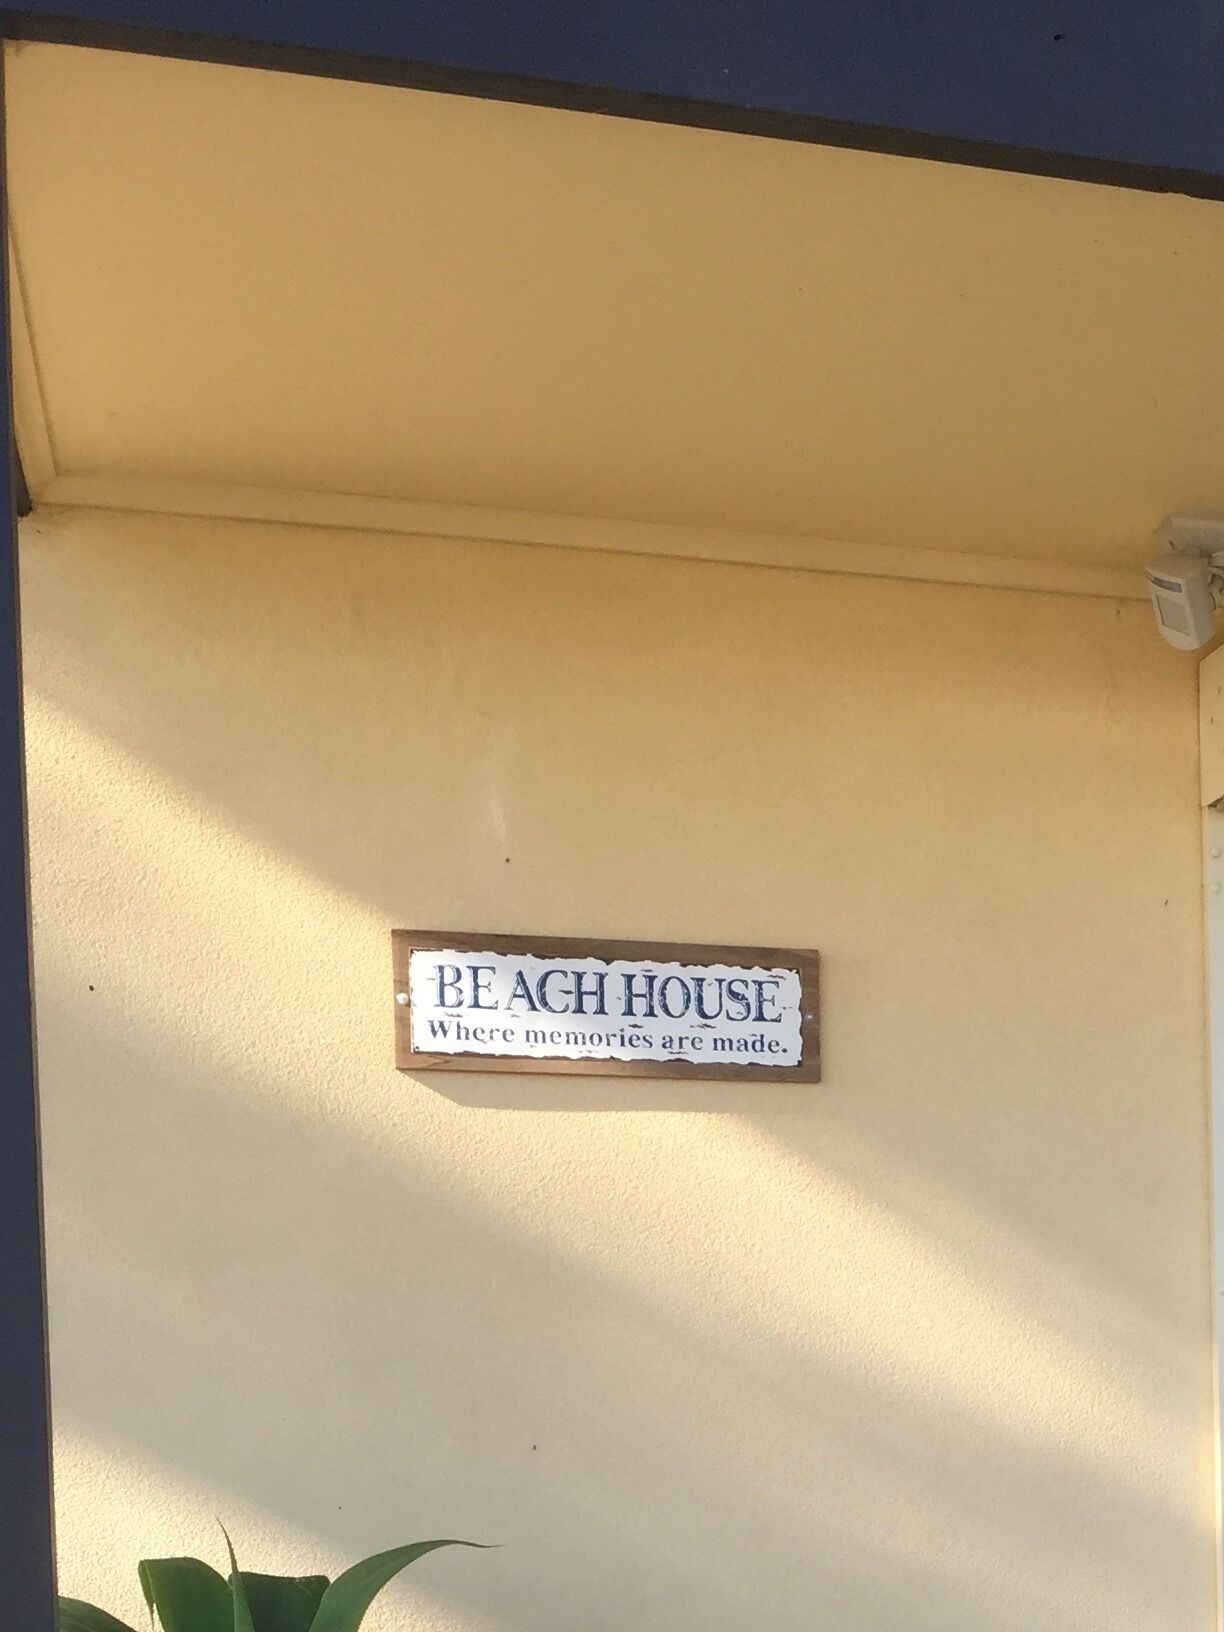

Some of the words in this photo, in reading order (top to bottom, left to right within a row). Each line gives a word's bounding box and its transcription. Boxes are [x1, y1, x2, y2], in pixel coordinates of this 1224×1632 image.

[433, 963, 608, 1017] BEACH
[620, 971, 782, 1023] HOUSE
[428, 1019, 515, 1044] Where
[524, 1027, 653, 1050] memories
[661, 1032, 704, 1051] are
[712, 1032, 788, 1054] made.
